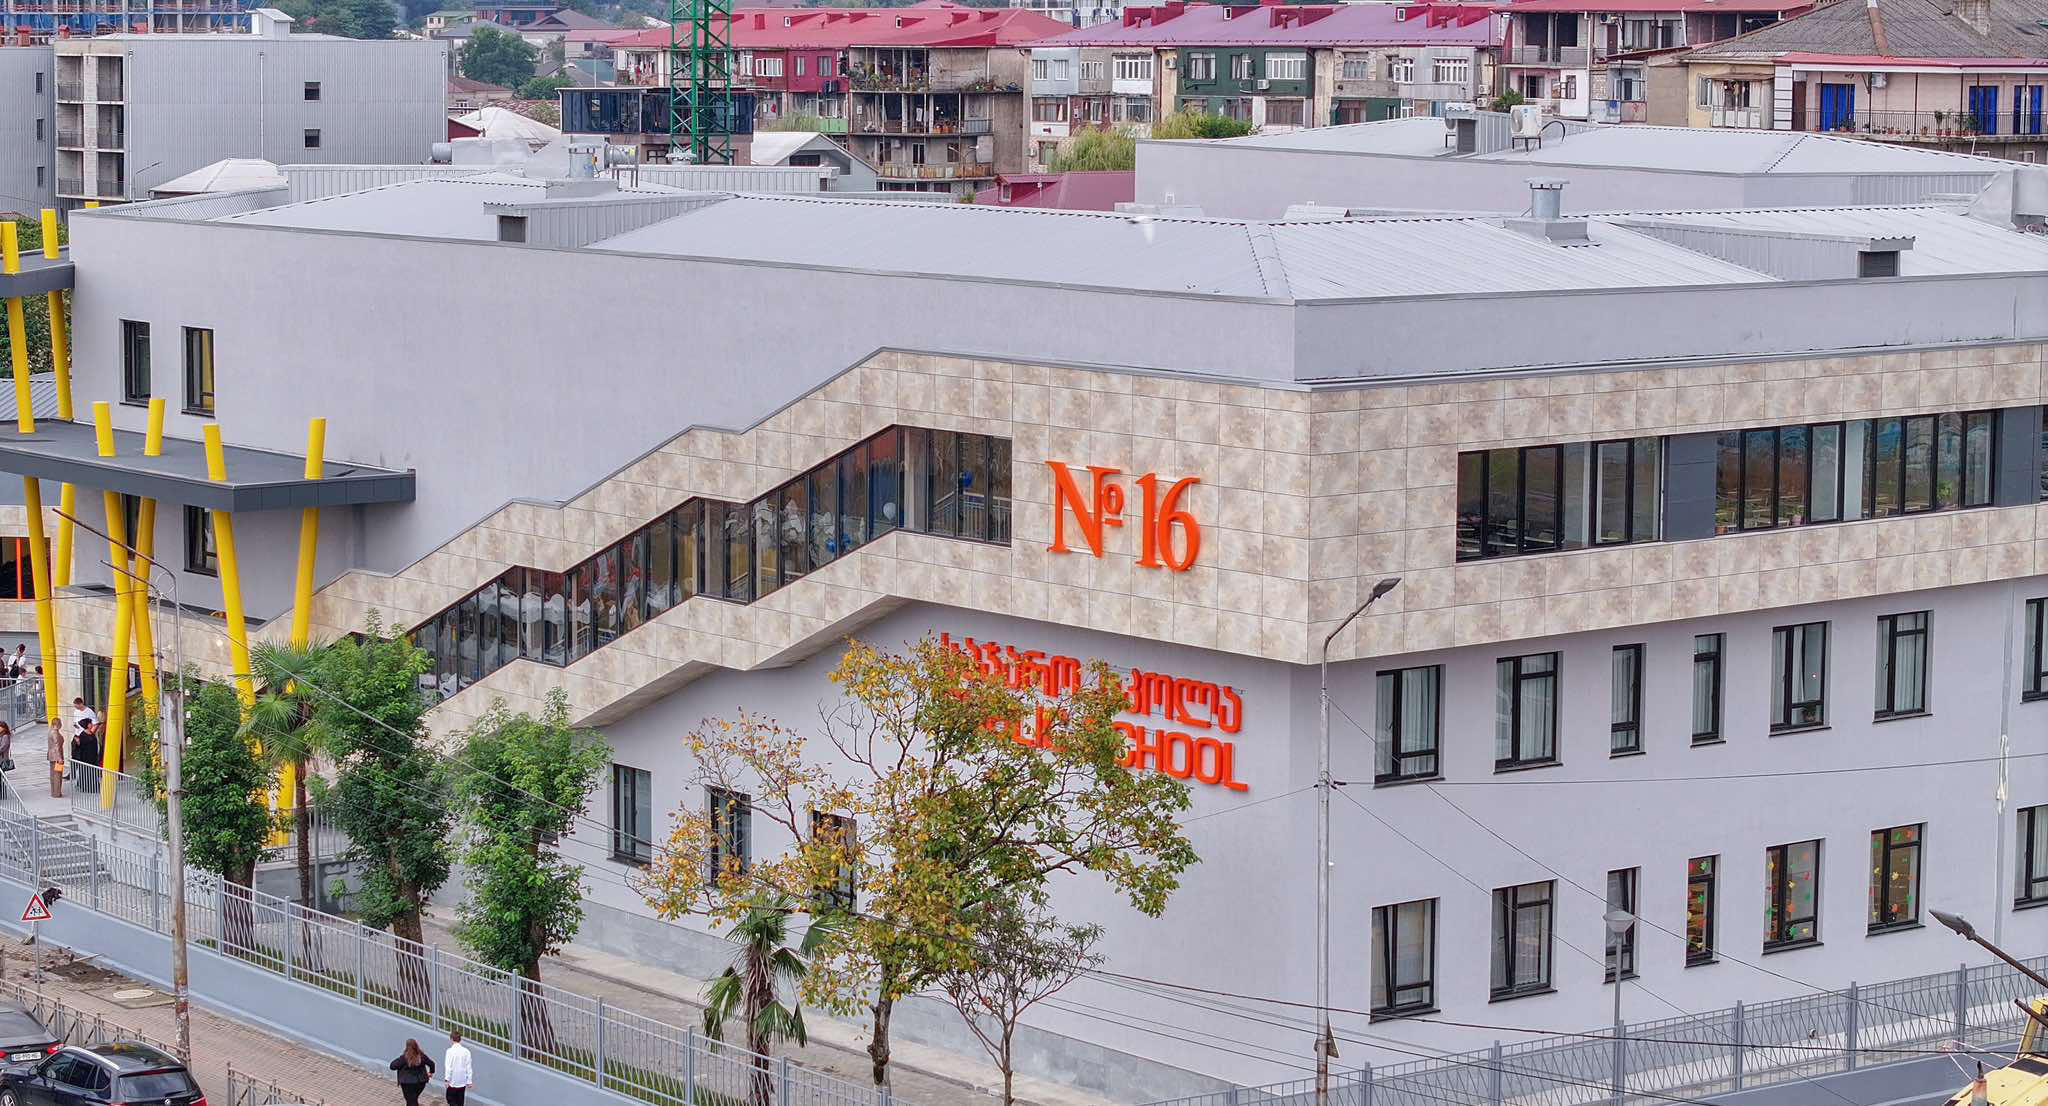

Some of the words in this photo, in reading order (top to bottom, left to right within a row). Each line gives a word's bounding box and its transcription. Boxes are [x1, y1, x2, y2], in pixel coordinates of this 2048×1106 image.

[1135, 473, 1201, 572] 16
[1100, 662, 1242, 733] კოლა
[1088, 720, 1249, 792] CHOOL
